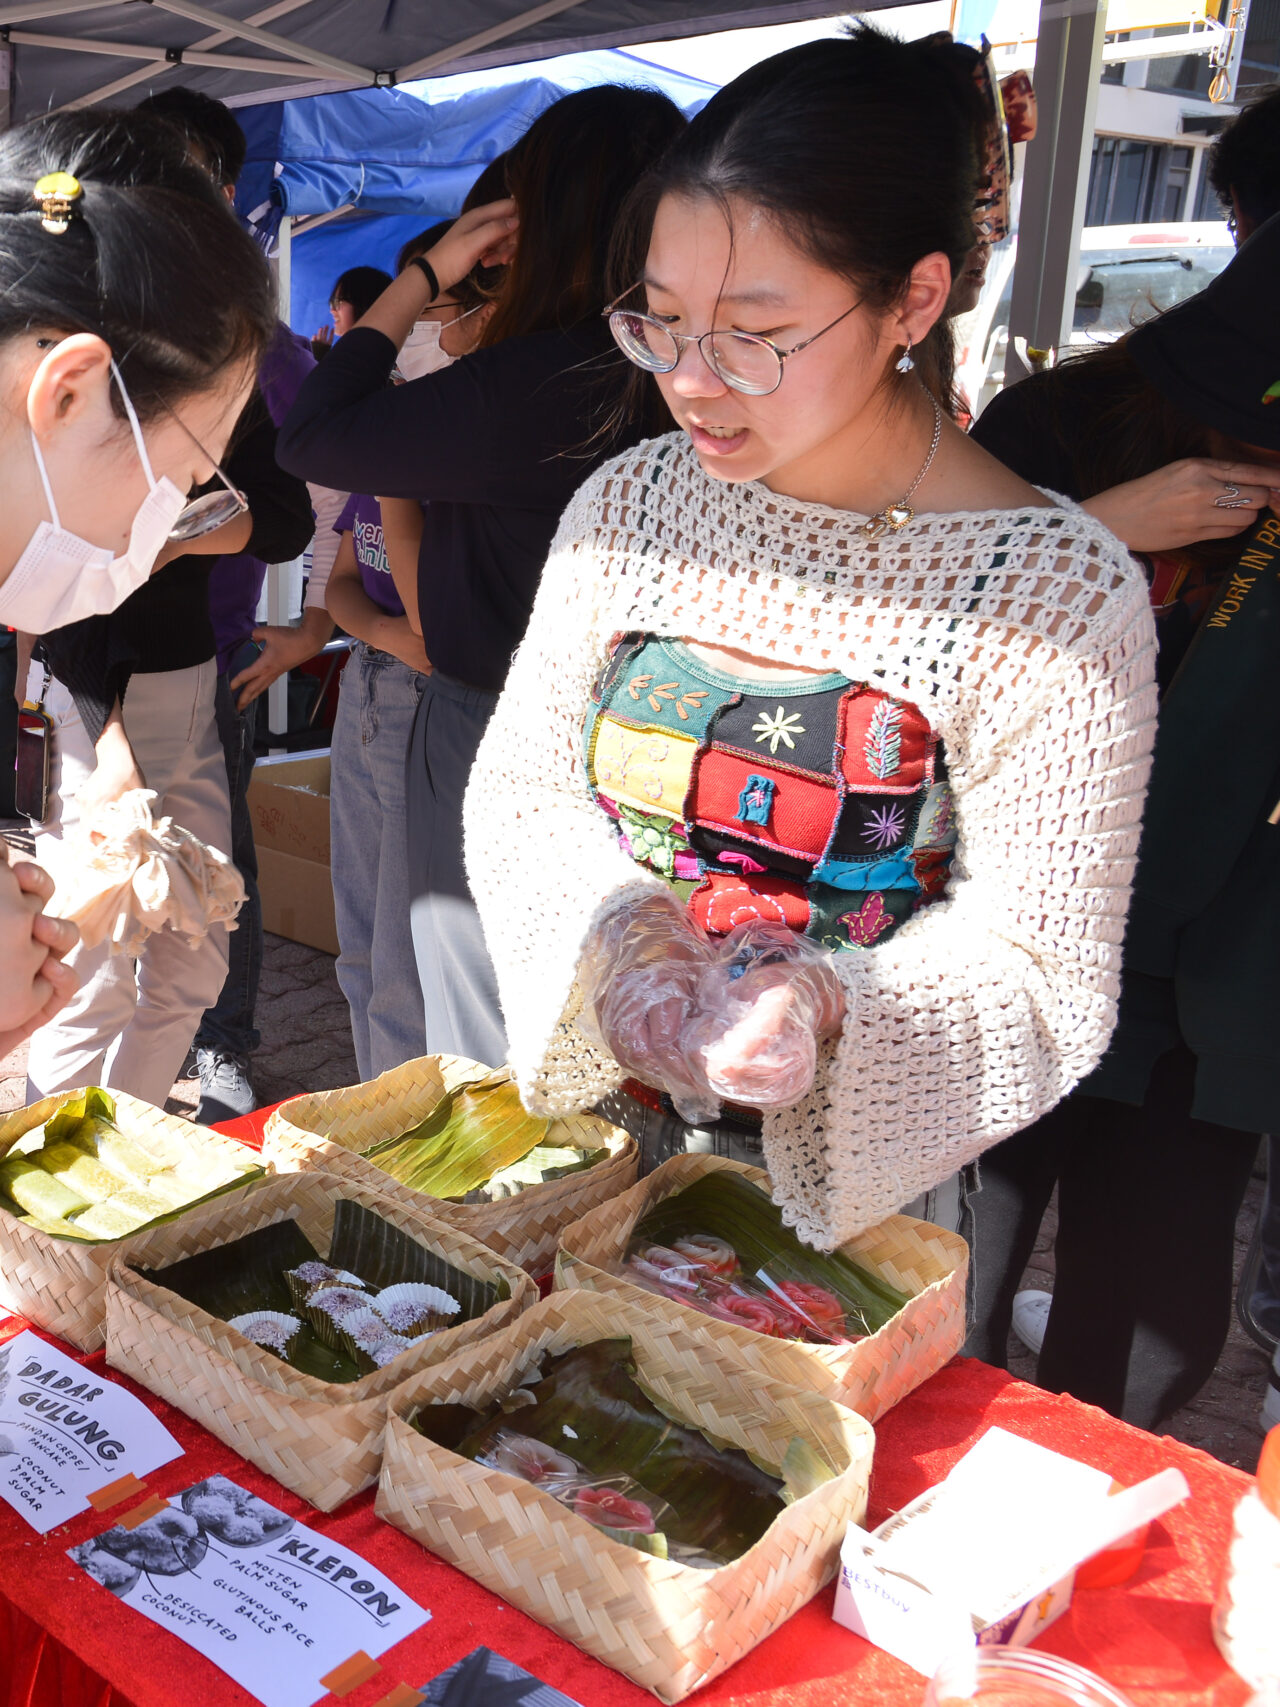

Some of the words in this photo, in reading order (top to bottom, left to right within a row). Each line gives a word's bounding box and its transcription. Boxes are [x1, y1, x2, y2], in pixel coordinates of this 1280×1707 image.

[1206, 572, 1257, 628] WORK
[1238, 547, 1275, 571] IN
[17, 1421, 57, 1444] PANDAN
[28, 1437, 67, 1468] PANCAKE
[18, 1471, 46, 1495] PALM
[21, 1456, 66, 1496] COCONUT
[7, 1479, 43, 1512] SUGAR
[229, 1559, 265, 1582] PALM
[264, 1581, 309, 1612] SUGAR
[251, 1560, 303, 1590] MOLTEN
[141, 1593, 197, 1626] COCONUT
[163, 1593, 238, 1642] DESICCATED
[212, 1578, 282, 1623] GLUTINOUS
[281, 1622, 315, 1648] RICE
[234, 1604, 276, 1635] BALLS
